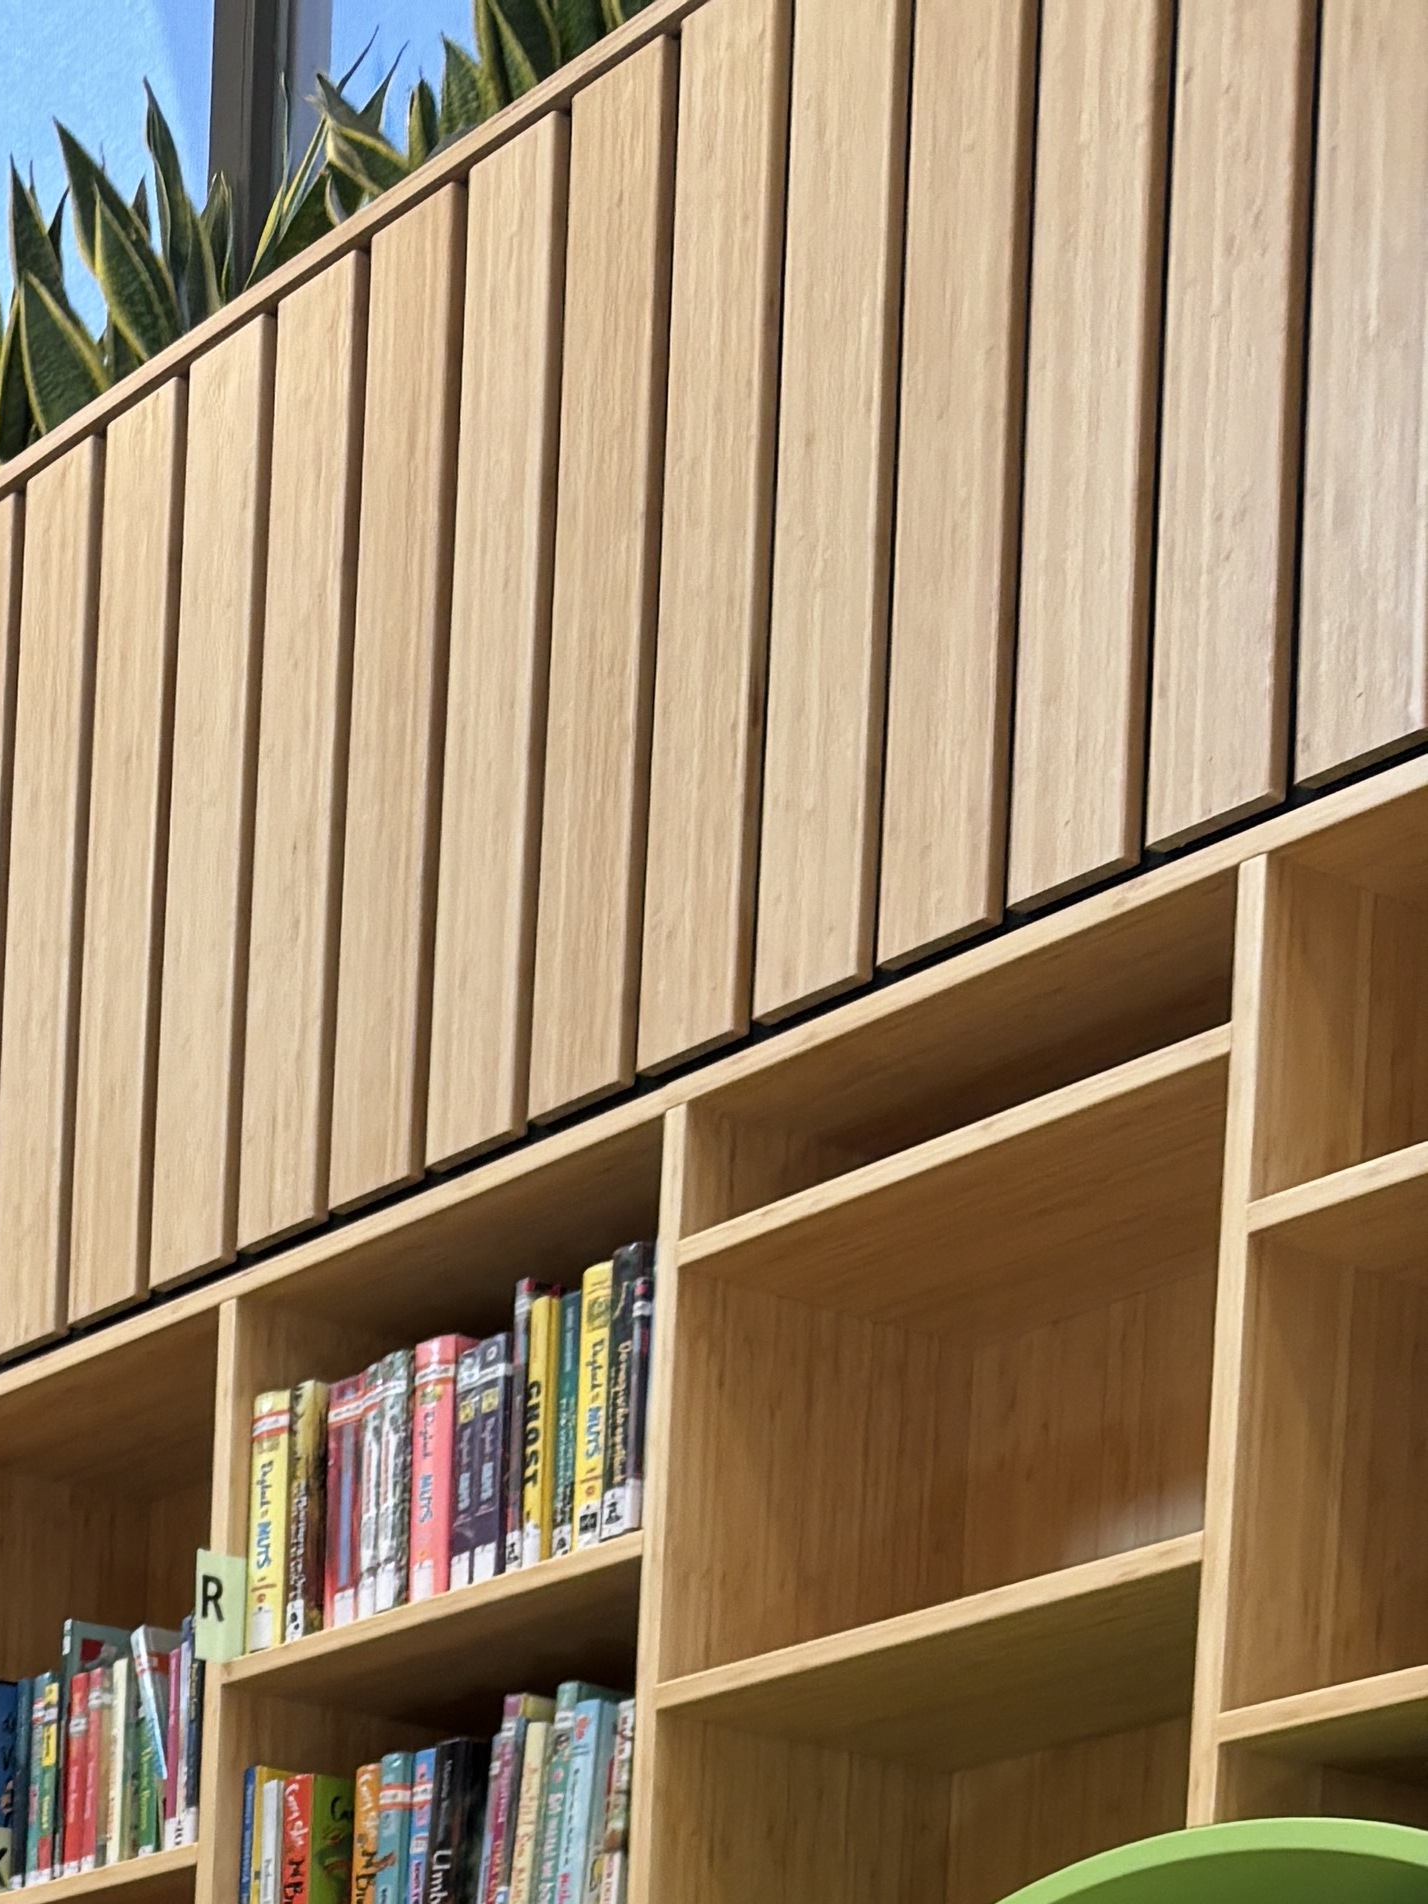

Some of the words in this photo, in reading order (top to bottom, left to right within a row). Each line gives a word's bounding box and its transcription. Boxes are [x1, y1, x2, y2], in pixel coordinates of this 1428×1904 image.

[584, 1406, 603, 1461] MUTS
[417, 1473, 434, 1525] MUTS
[255, 1520, 272, 1571] MUTS
[201, 1574, 225, 1622] R
